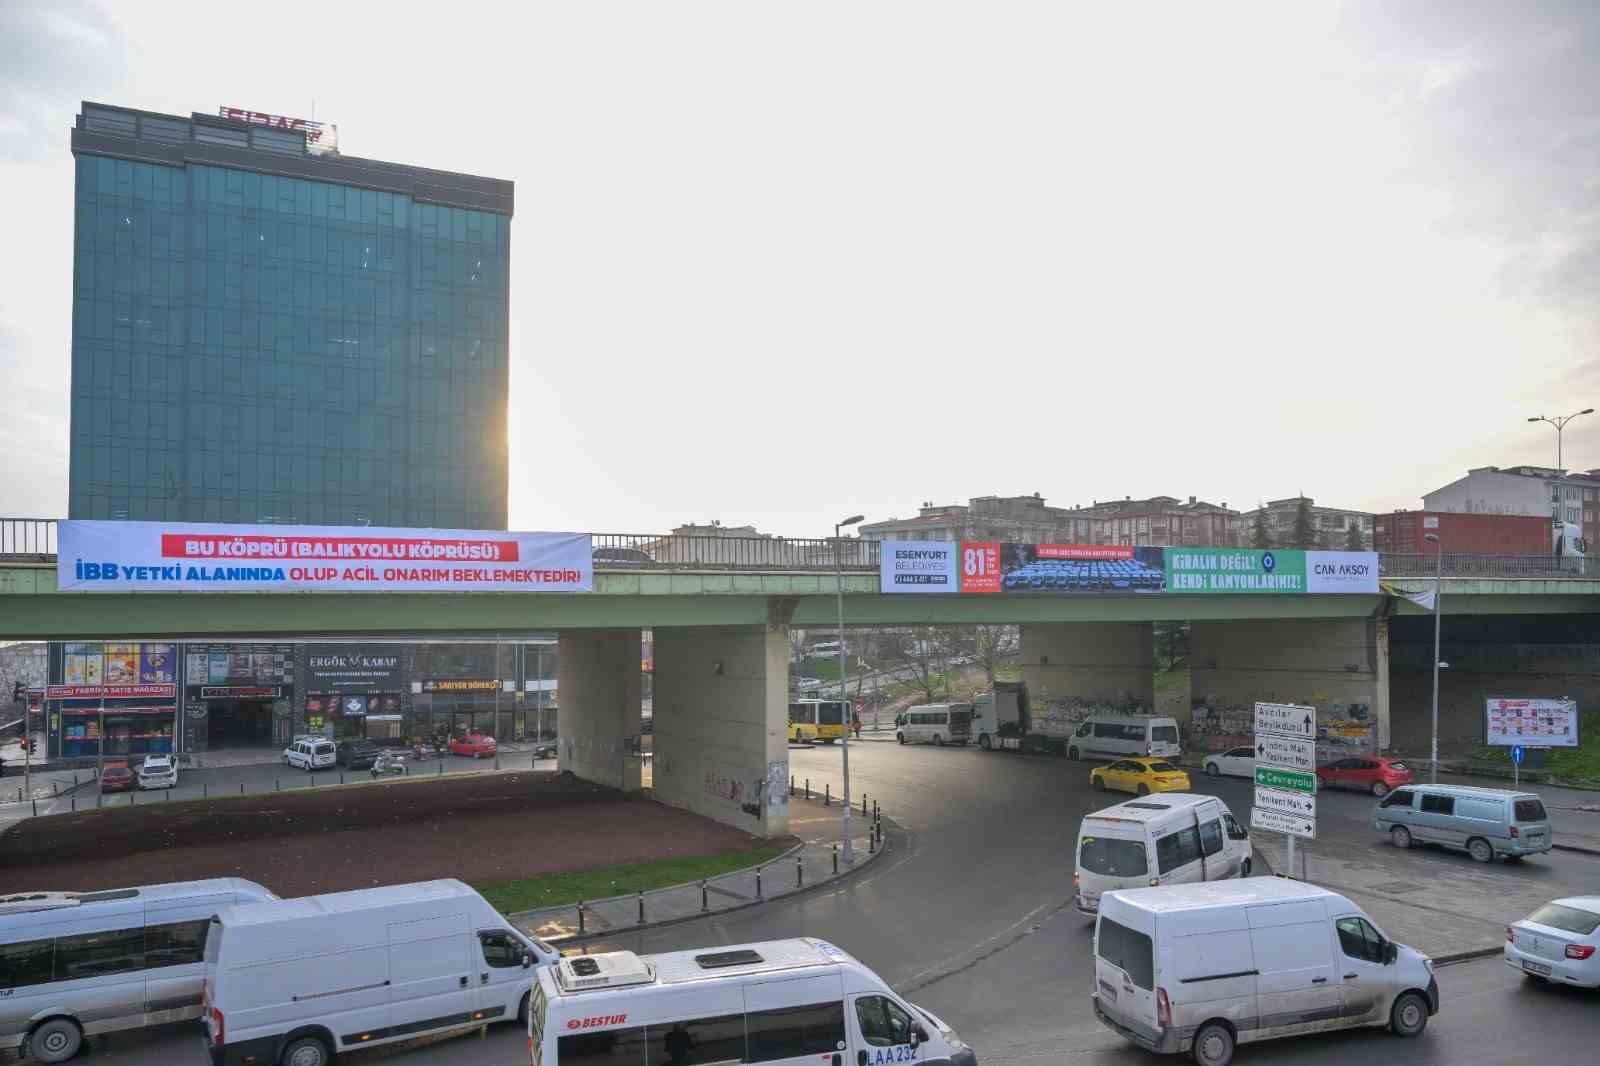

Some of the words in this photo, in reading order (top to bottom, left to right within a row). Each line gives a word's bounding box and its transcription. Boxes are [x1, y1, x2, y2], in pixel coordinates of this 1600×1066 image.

[185, 539, 215, 556] BU
[219, 537, 288, 558] KÖPRÜ
[291, 540, 407, 559] (BALIKYOLU
[409, 541, 500, 560] KÖPRÜSÜ)
[895, 550, 948, 560] ESENYURT
[964, 548, 986, 576] 81
[1172, 554, 1217, 570] KİRALIK
[1220, 553, 1256, 570] DEĞİL!
[75, 559, 119, 580] İBB
[121, 563, 182, 581] YETKİ
[186, 567, 286, 581] ALANINDA
[288, 567, 338, 581] OLUP
[342, 565, 379, 582] ACİL
[383, 568, 450, 582] ONARIM
[453, 567, 581, 583] BEKLEMEKTEDİR!
[1314, 564, 1335, 575] CAN
[1338, 565, 1369, 577] AKSOY
[1172, 574, 1208, 589] KENDİ
[1210, 574, 1301, 590] KAMYONLARIMIZ!
[309, 656, 346, 667] ERGÖK
[582, 1013, 628, 1028] BESTUR
